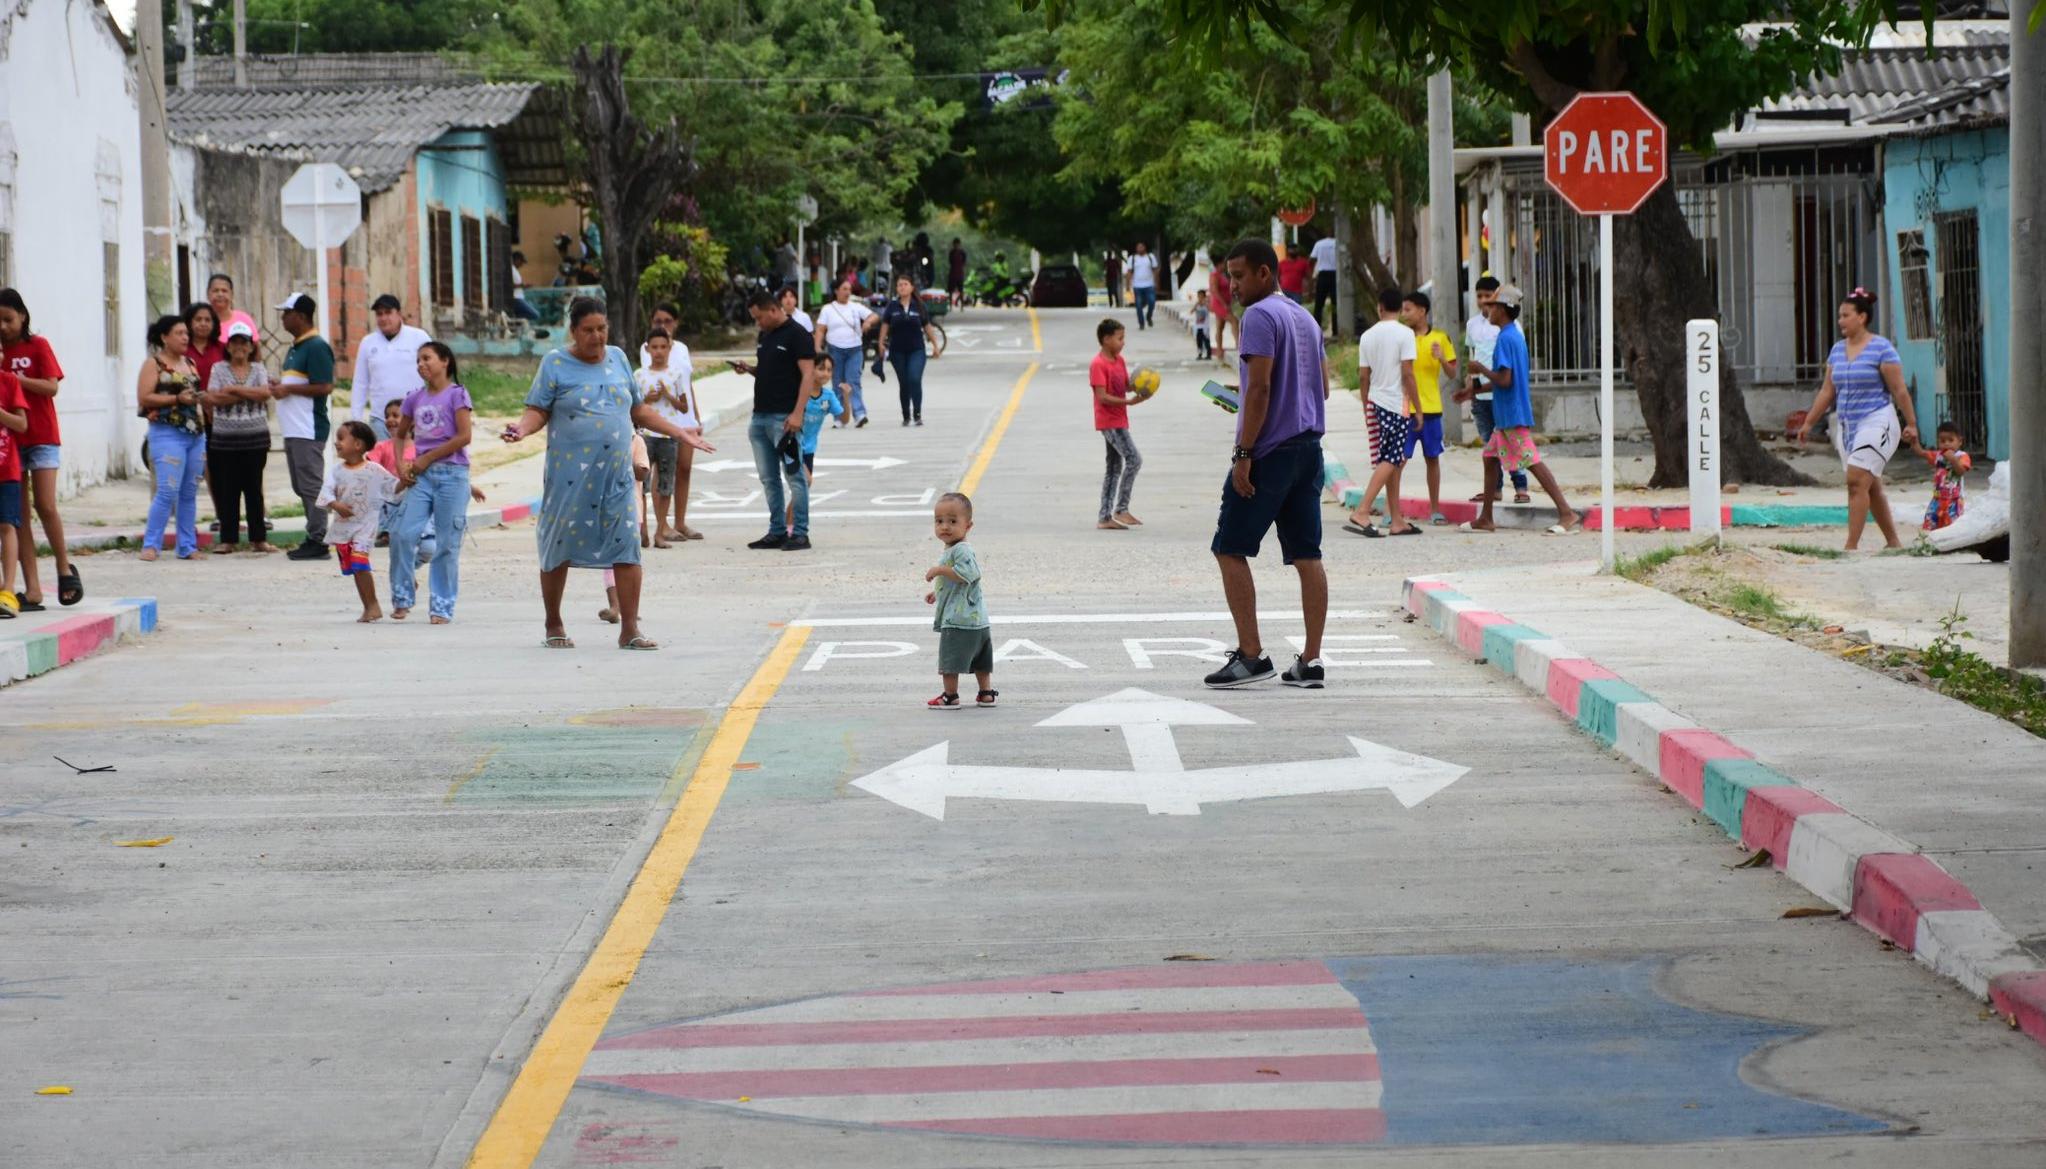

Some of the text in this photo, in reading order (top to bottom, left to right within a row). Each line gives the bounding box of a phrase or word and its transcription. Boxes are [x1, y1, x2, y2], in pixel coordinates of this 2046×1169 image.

[1558, 129, 1653, 174] PARE
[1697, 331, 1711, 471] 25 CALLE
[801, 635, 1434, 672] PARE
